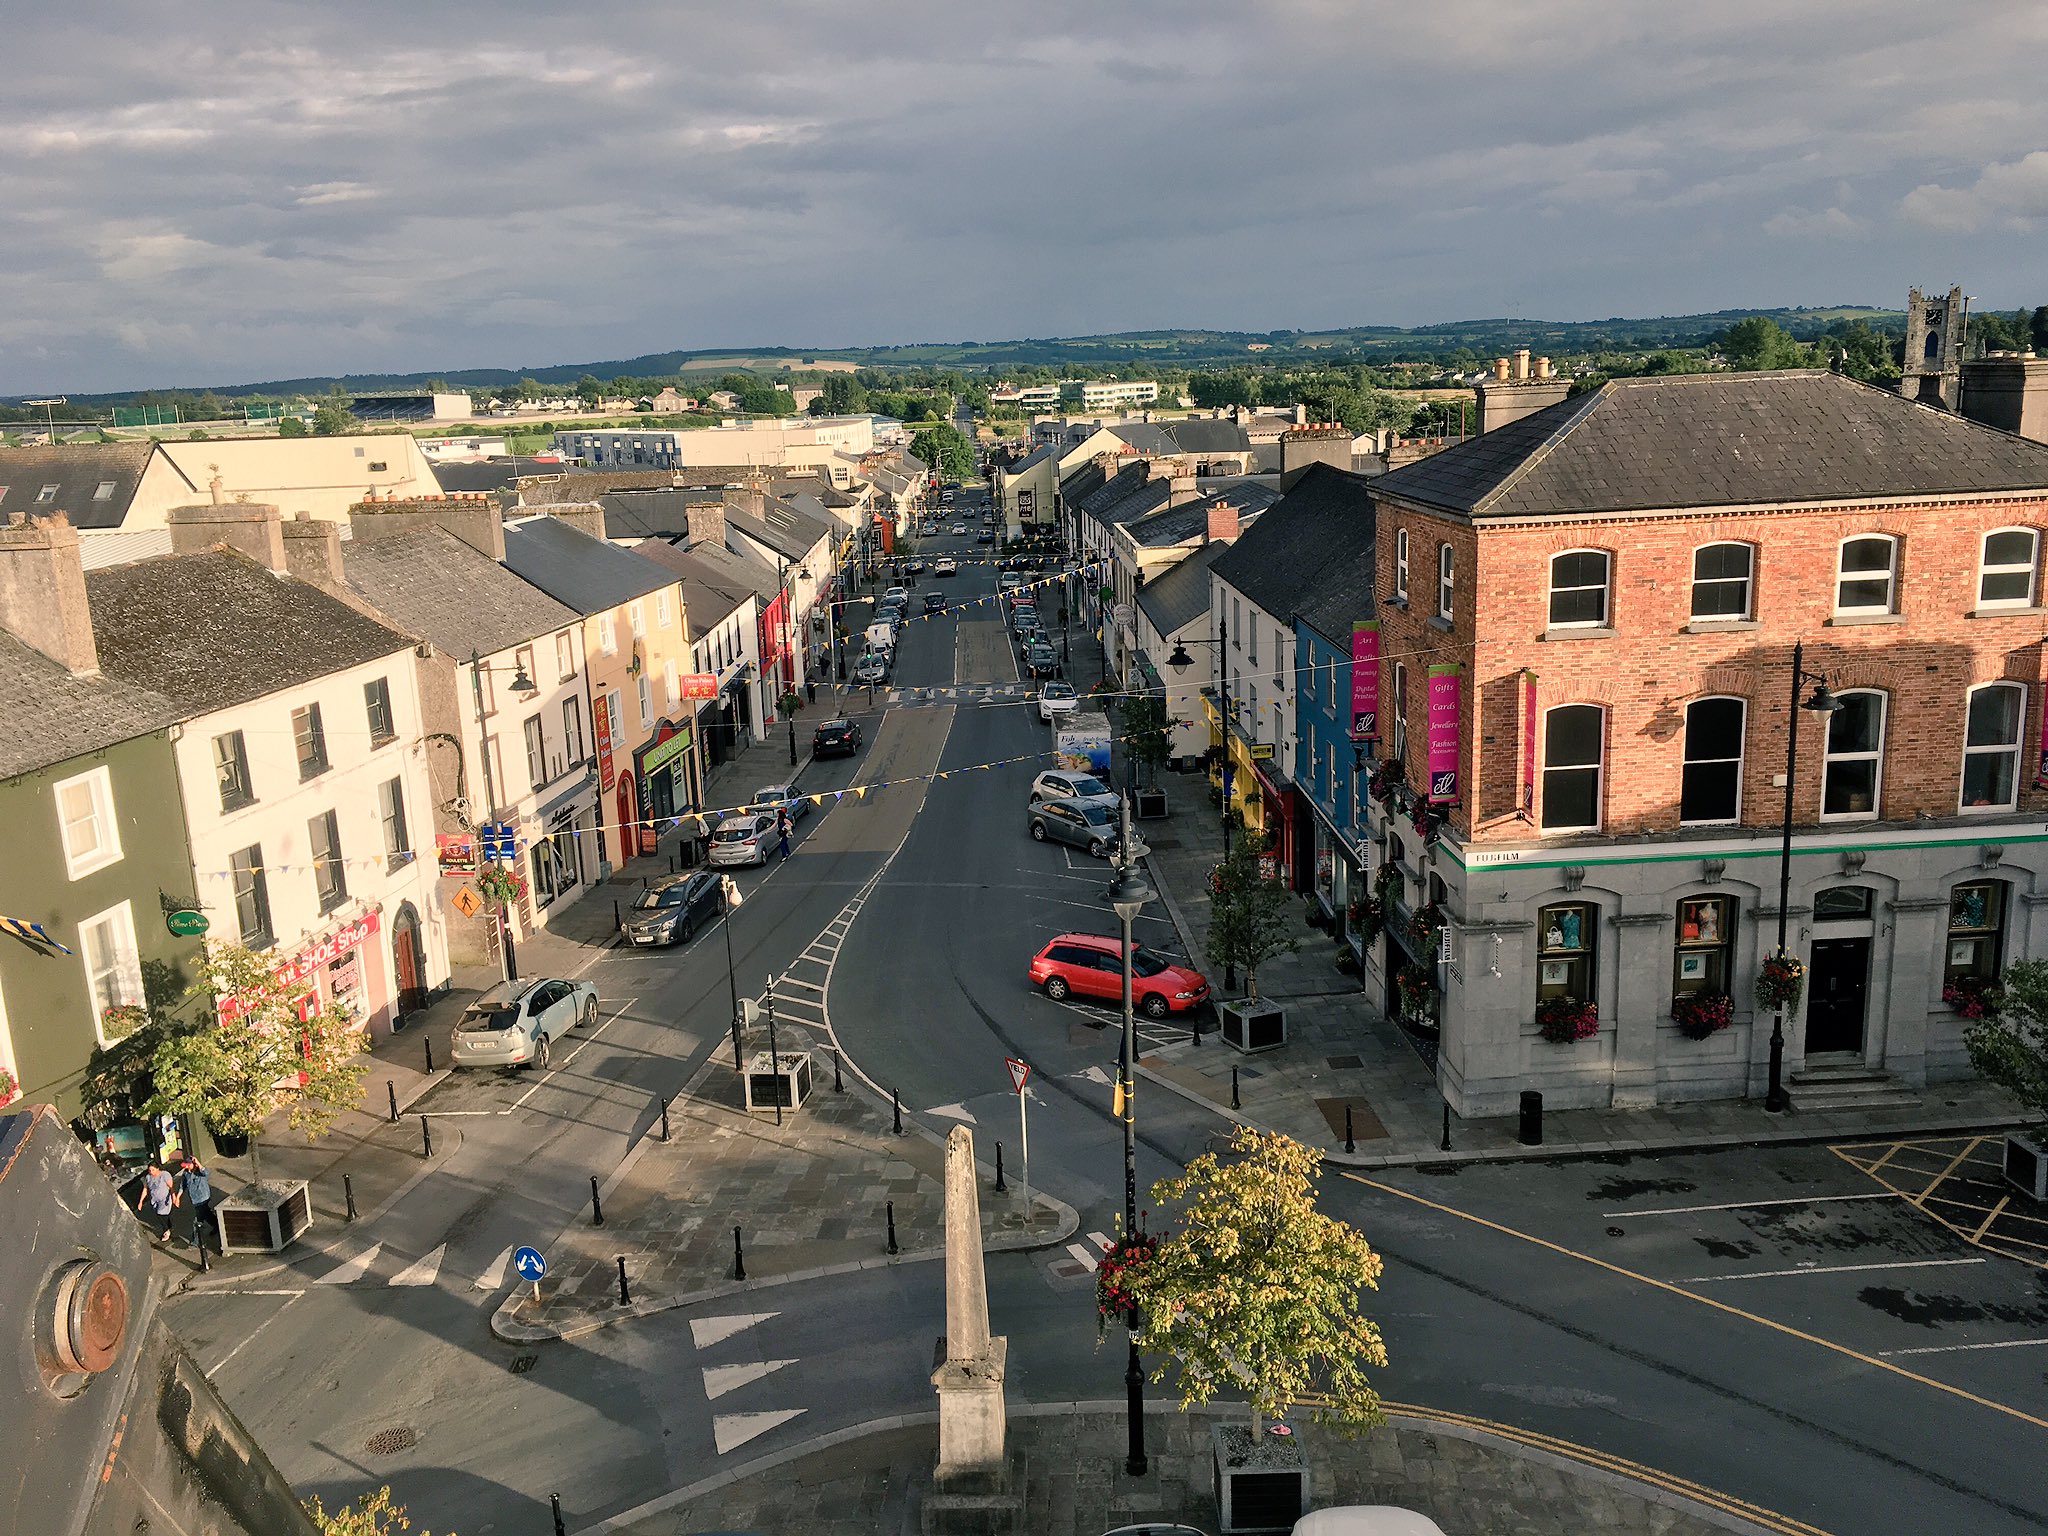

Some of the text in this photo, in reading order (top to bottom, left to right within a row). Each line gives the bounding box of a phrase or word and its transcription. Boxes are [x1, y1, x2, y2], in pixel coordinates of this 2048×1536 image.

[1356, 685, 1376, 693] Digital
[1434, 683, 1454, 693] Gifts
[1432, 702, 1456, 711] Cards
[1431, 740, 1456, 749] Fashion
[1476, 853, 1519, 862] FUJIFILM
[299, 923, 369, 975] SHOE Shop
[1009, 1062, 1025, 1074] YIELD
